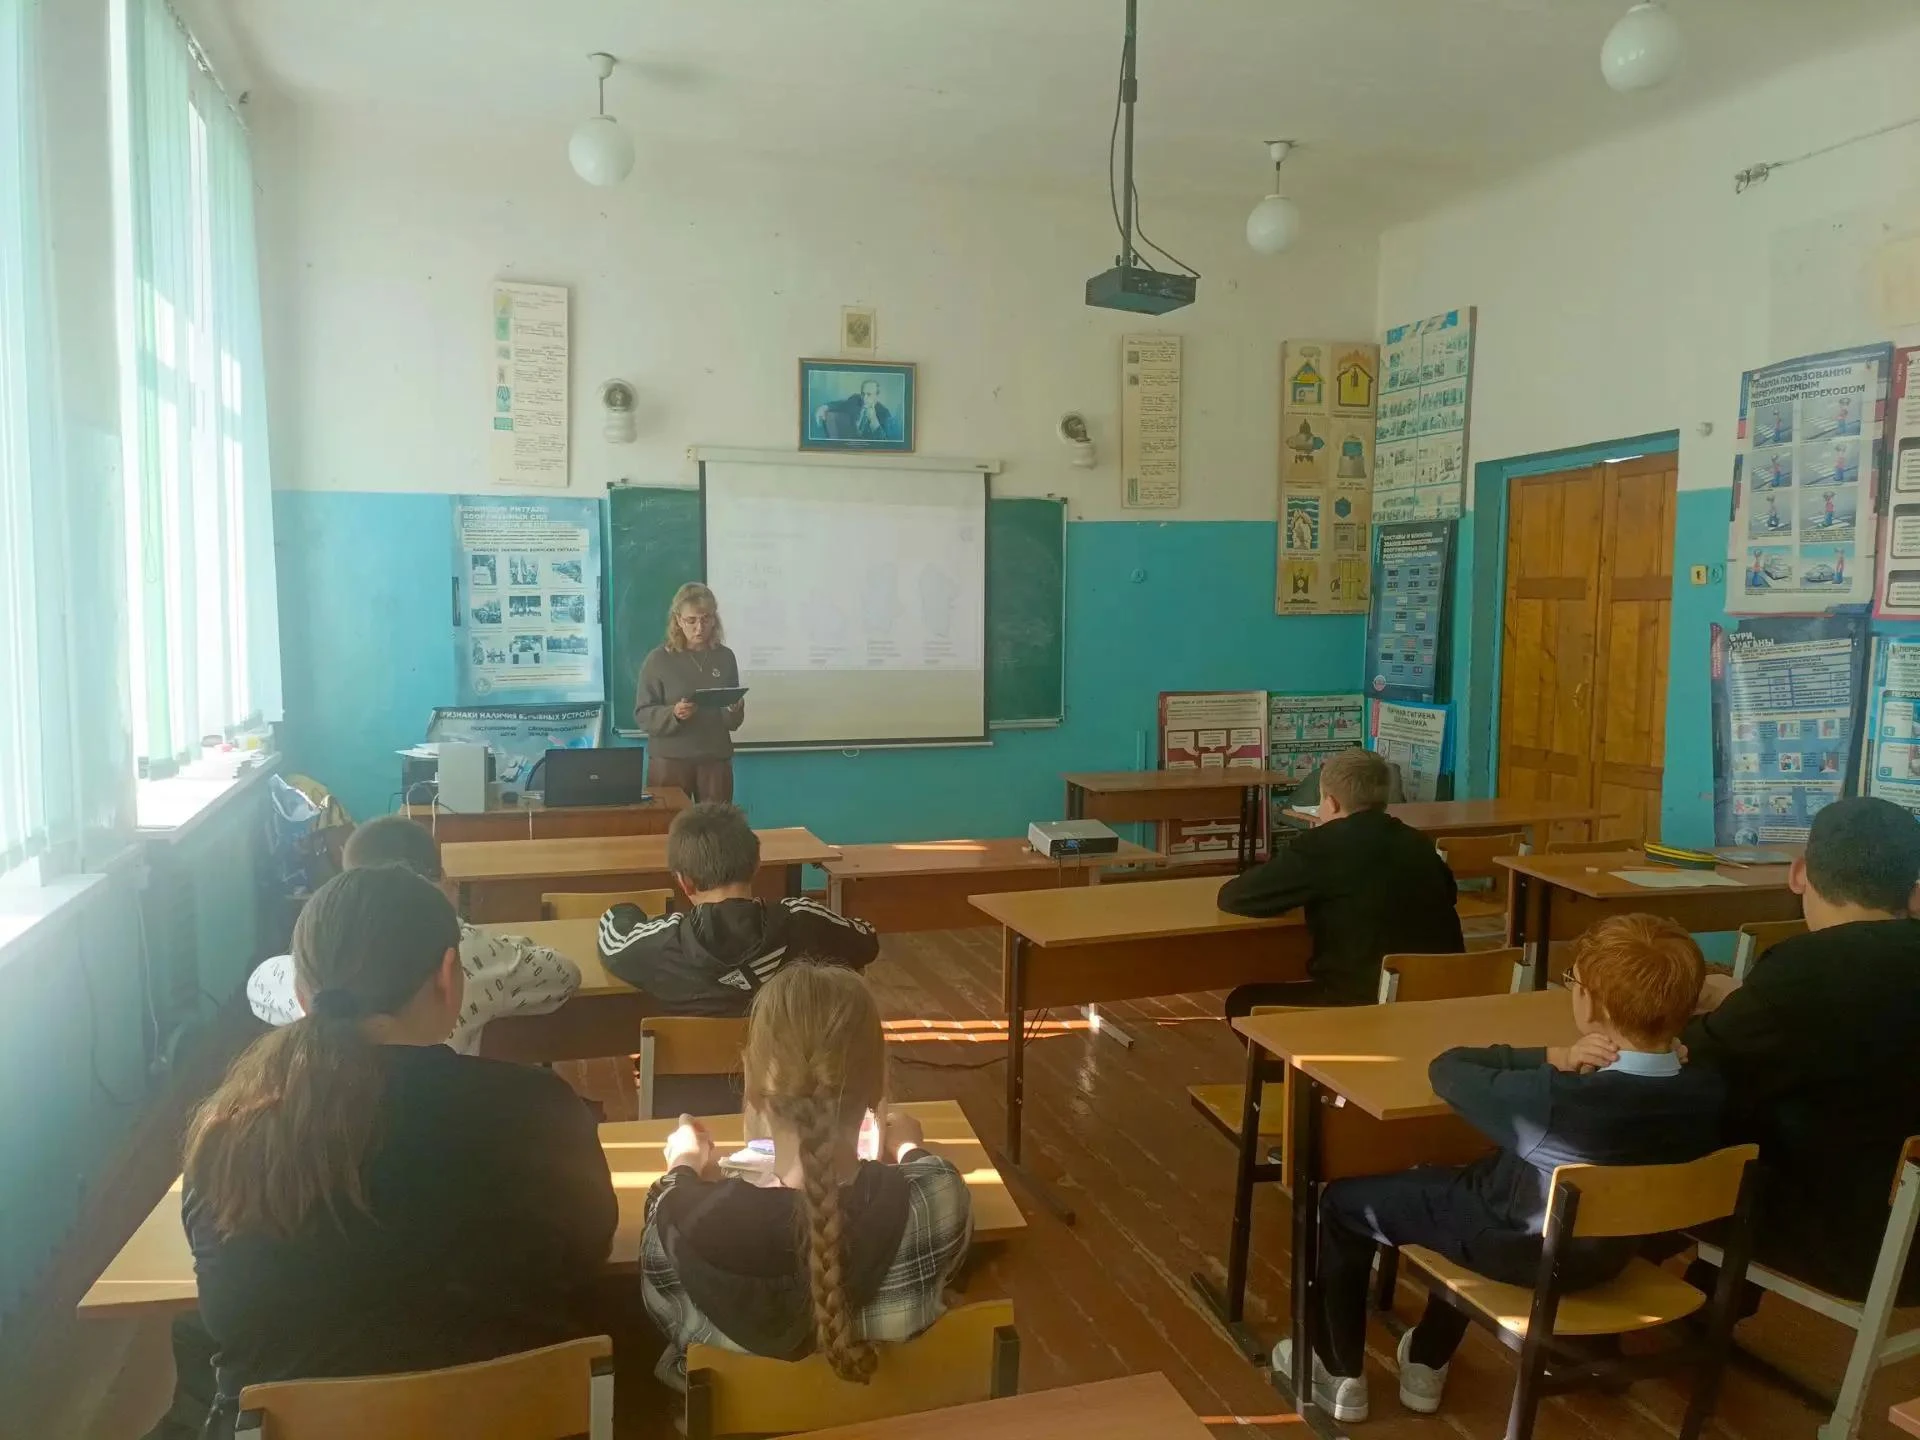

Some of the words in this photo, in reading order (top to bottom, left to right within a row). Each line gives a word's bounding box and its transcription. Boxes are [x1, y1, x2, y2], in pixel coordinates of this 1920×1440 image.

[1780, 367, 1852, 383] ПОЛЬЗОВАНИЯ
[1801, 384, 1866, 400] ПЕРЕХОДОМ
[479, 712, 517, 720] НАЛИЧИЯ
